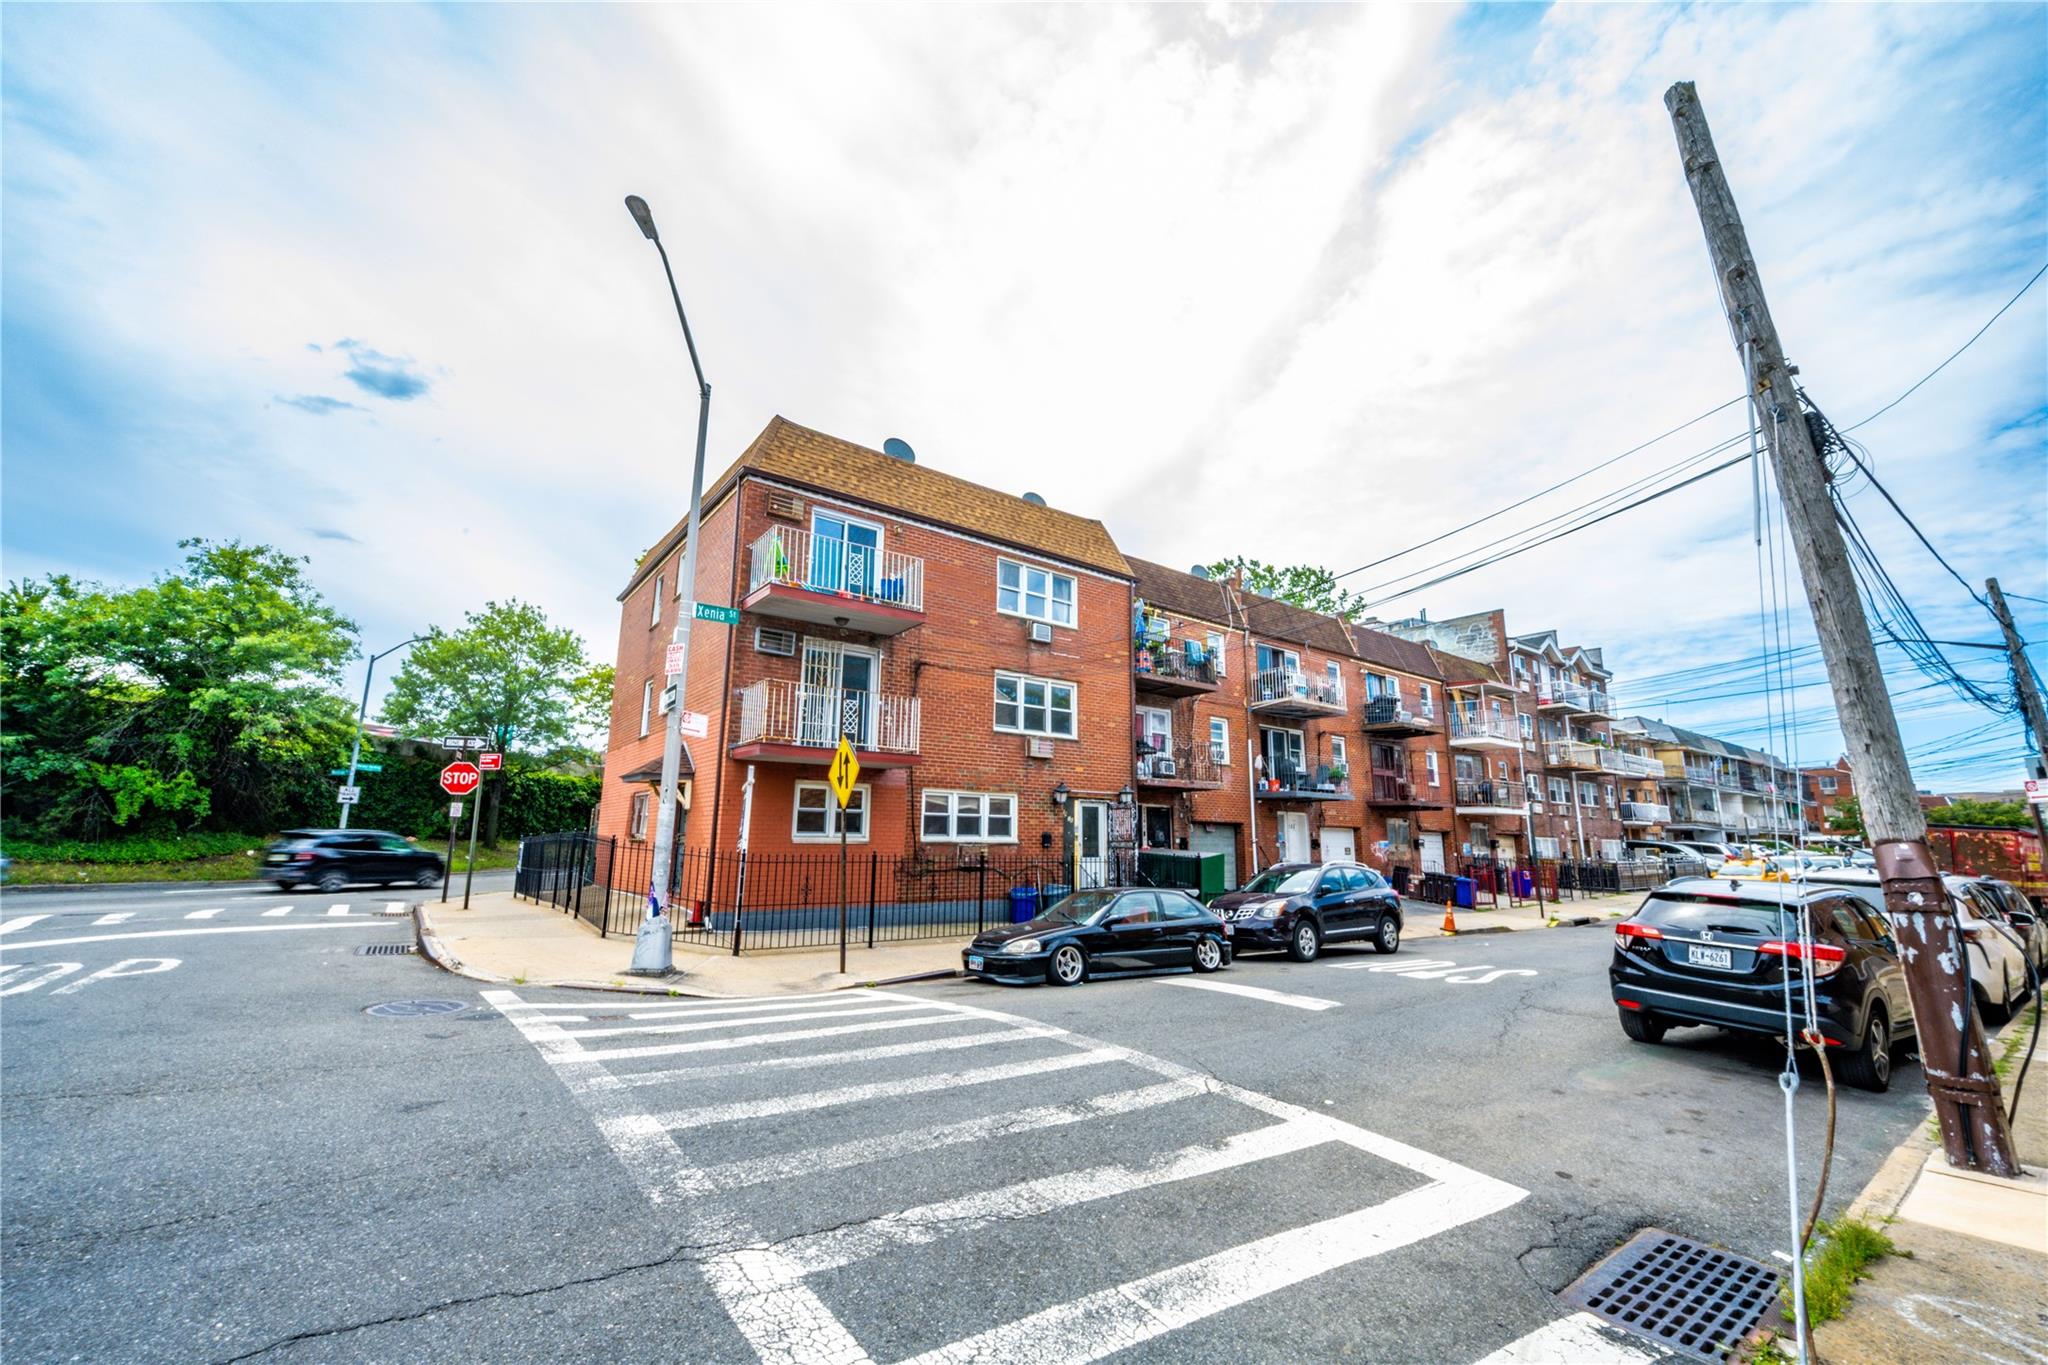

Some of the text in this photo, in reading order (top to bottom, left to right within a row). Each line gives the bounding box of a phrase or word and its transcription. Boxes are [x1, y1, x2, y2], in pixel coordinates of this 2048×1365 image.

[697, 604, 737, 621] Xenia St
[668, 645, 684, 653] CASH
[443, 772, 477, 785] STOP
[1325, 959, 1539, 984] STOP
